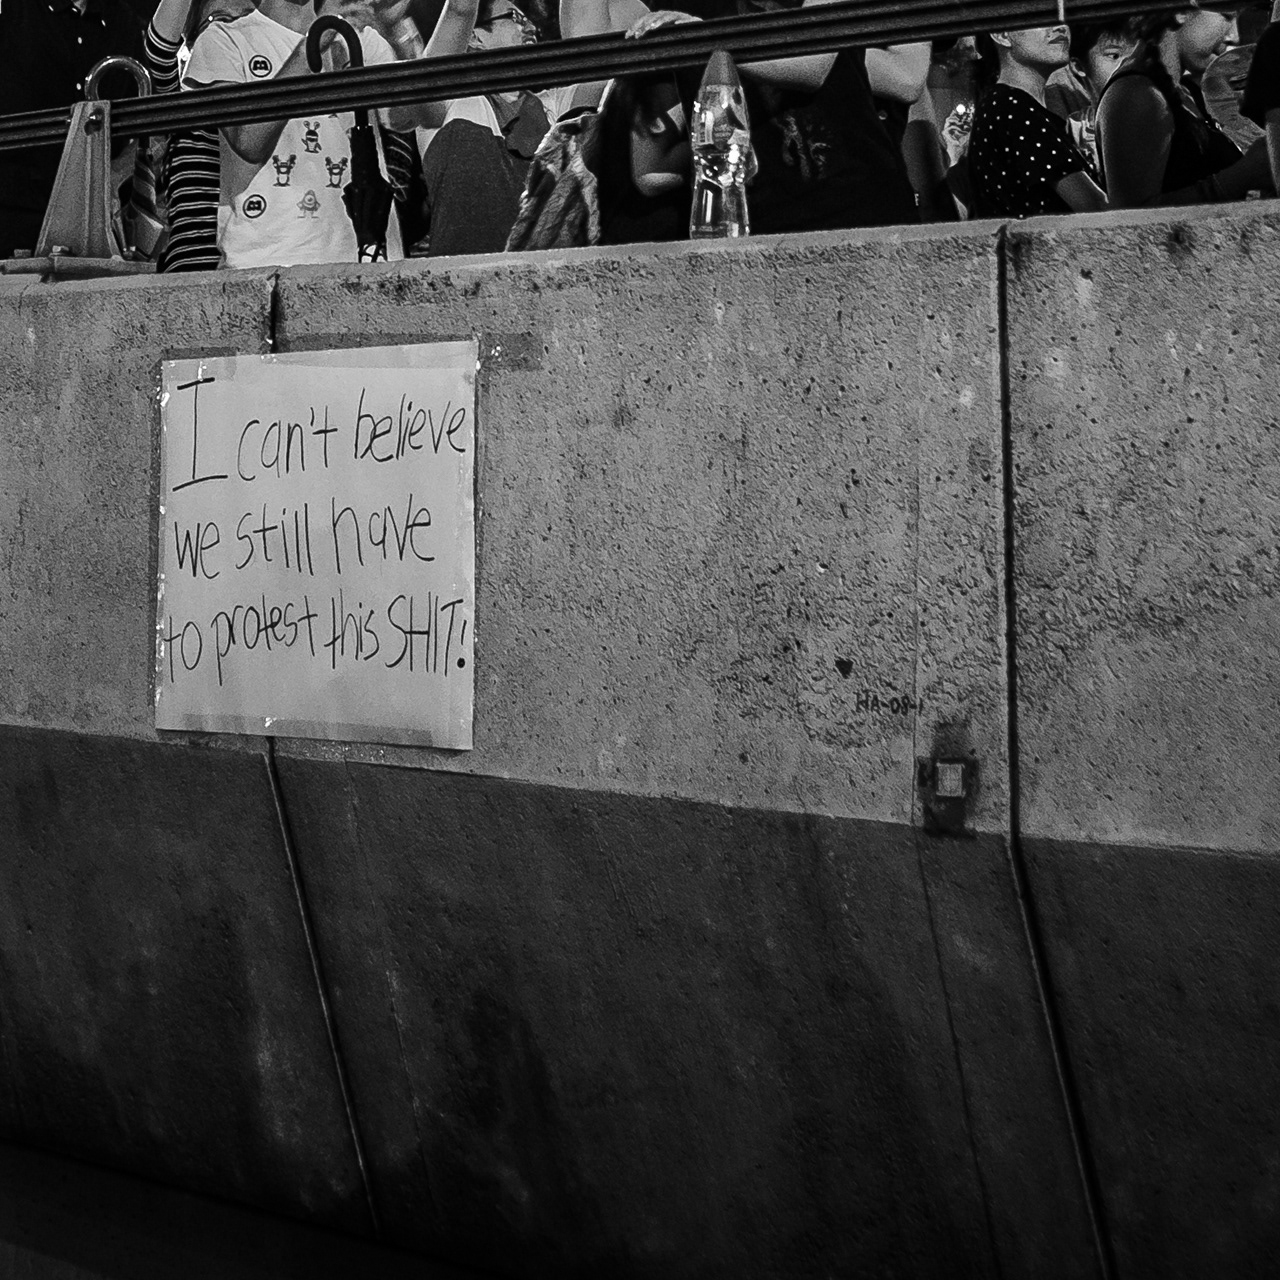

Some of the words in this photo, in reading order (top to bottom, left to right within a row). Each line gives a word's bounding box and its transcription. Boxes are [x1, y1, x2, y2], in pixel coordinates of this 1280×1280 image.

[173, 377, 228, 492] I
[237, 405, 338, 481] can't
[354, 388, 466, 462] believe
[174, 521, 220, 579] we
[236, 503, 314, 576] still
[332, 493, 435, 574] have
[164, 616, 202, 683] to
[211, 592, 318, 687] protest
[324, 588, 379, 669] this
[385, 591, 467, 677] SHIT!
